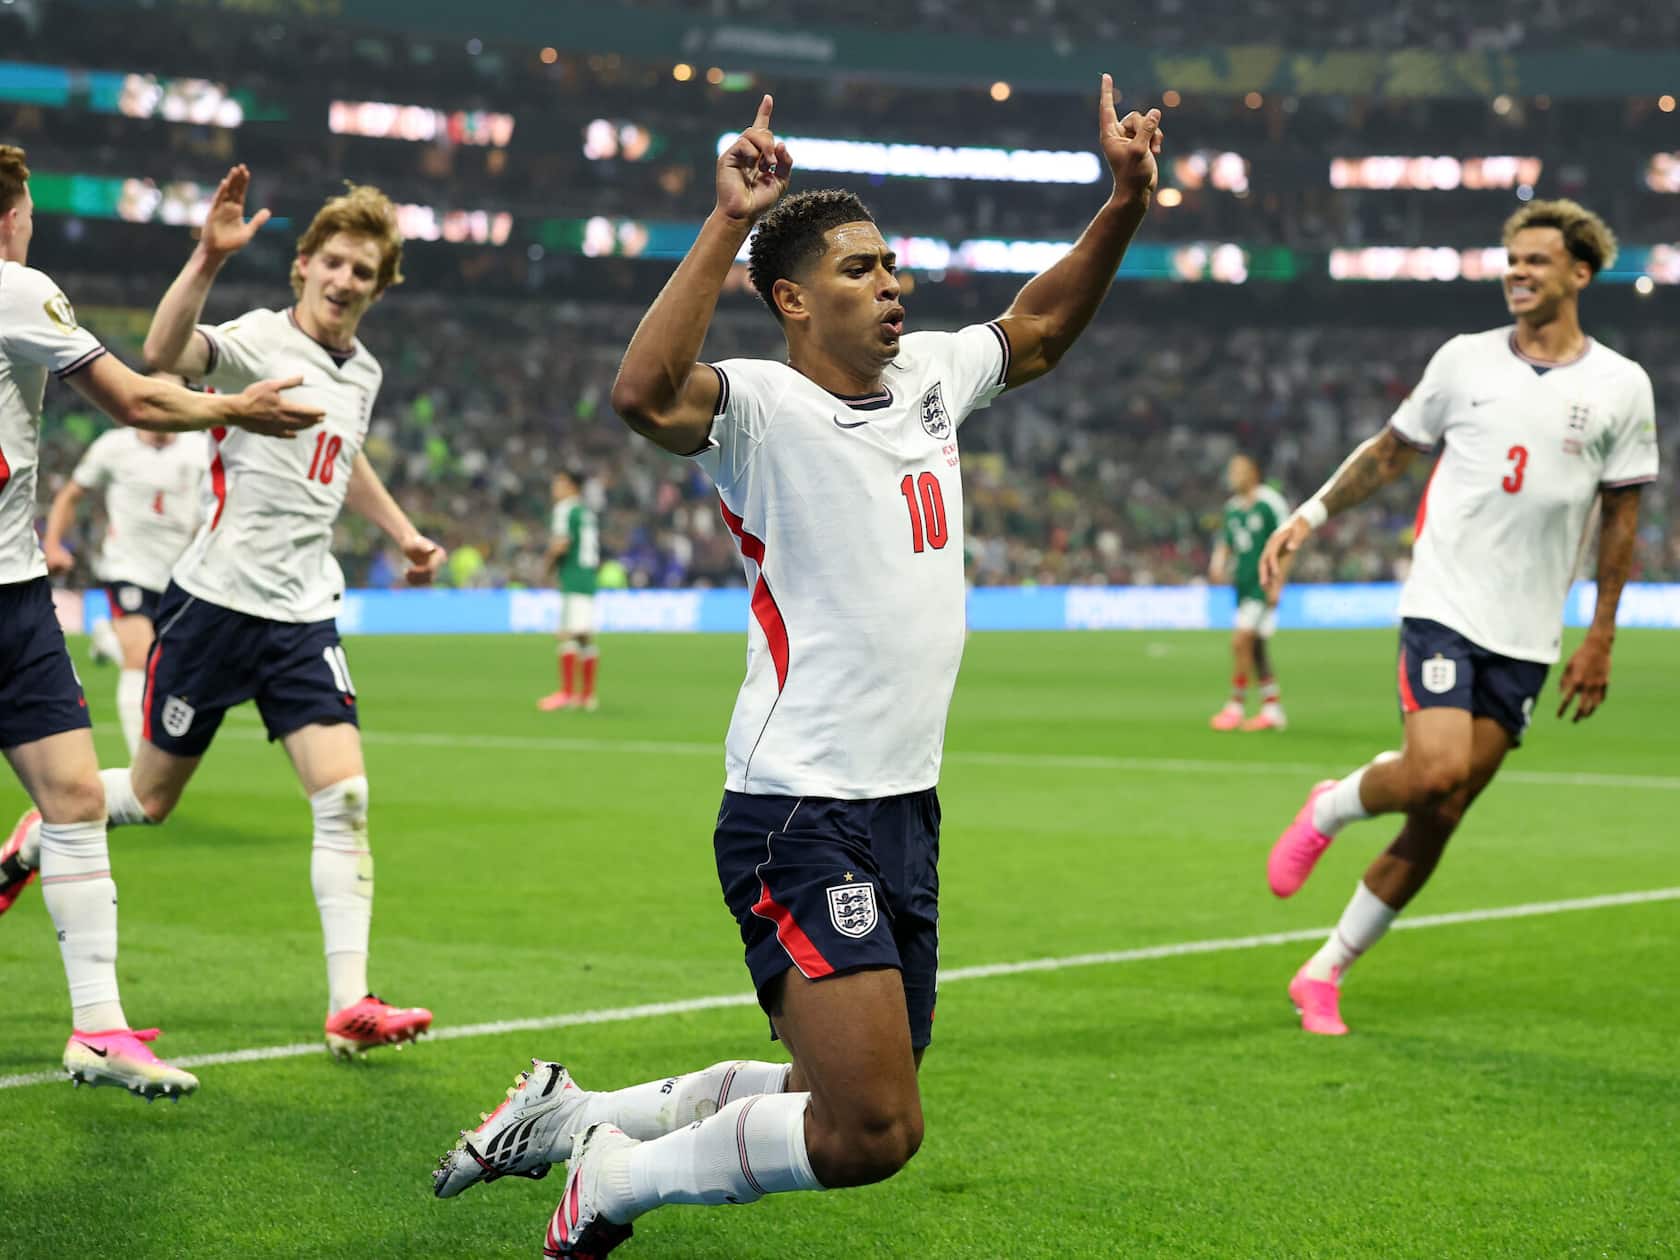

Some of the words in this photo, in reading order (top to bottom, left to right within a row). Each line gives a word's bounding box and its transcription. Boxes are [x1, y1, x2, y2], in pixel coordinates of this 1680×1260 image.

[308, 430, 342, 485] 18
[1501, 445, 1528, 495] 3
[900, 471, 949, 554] 10
